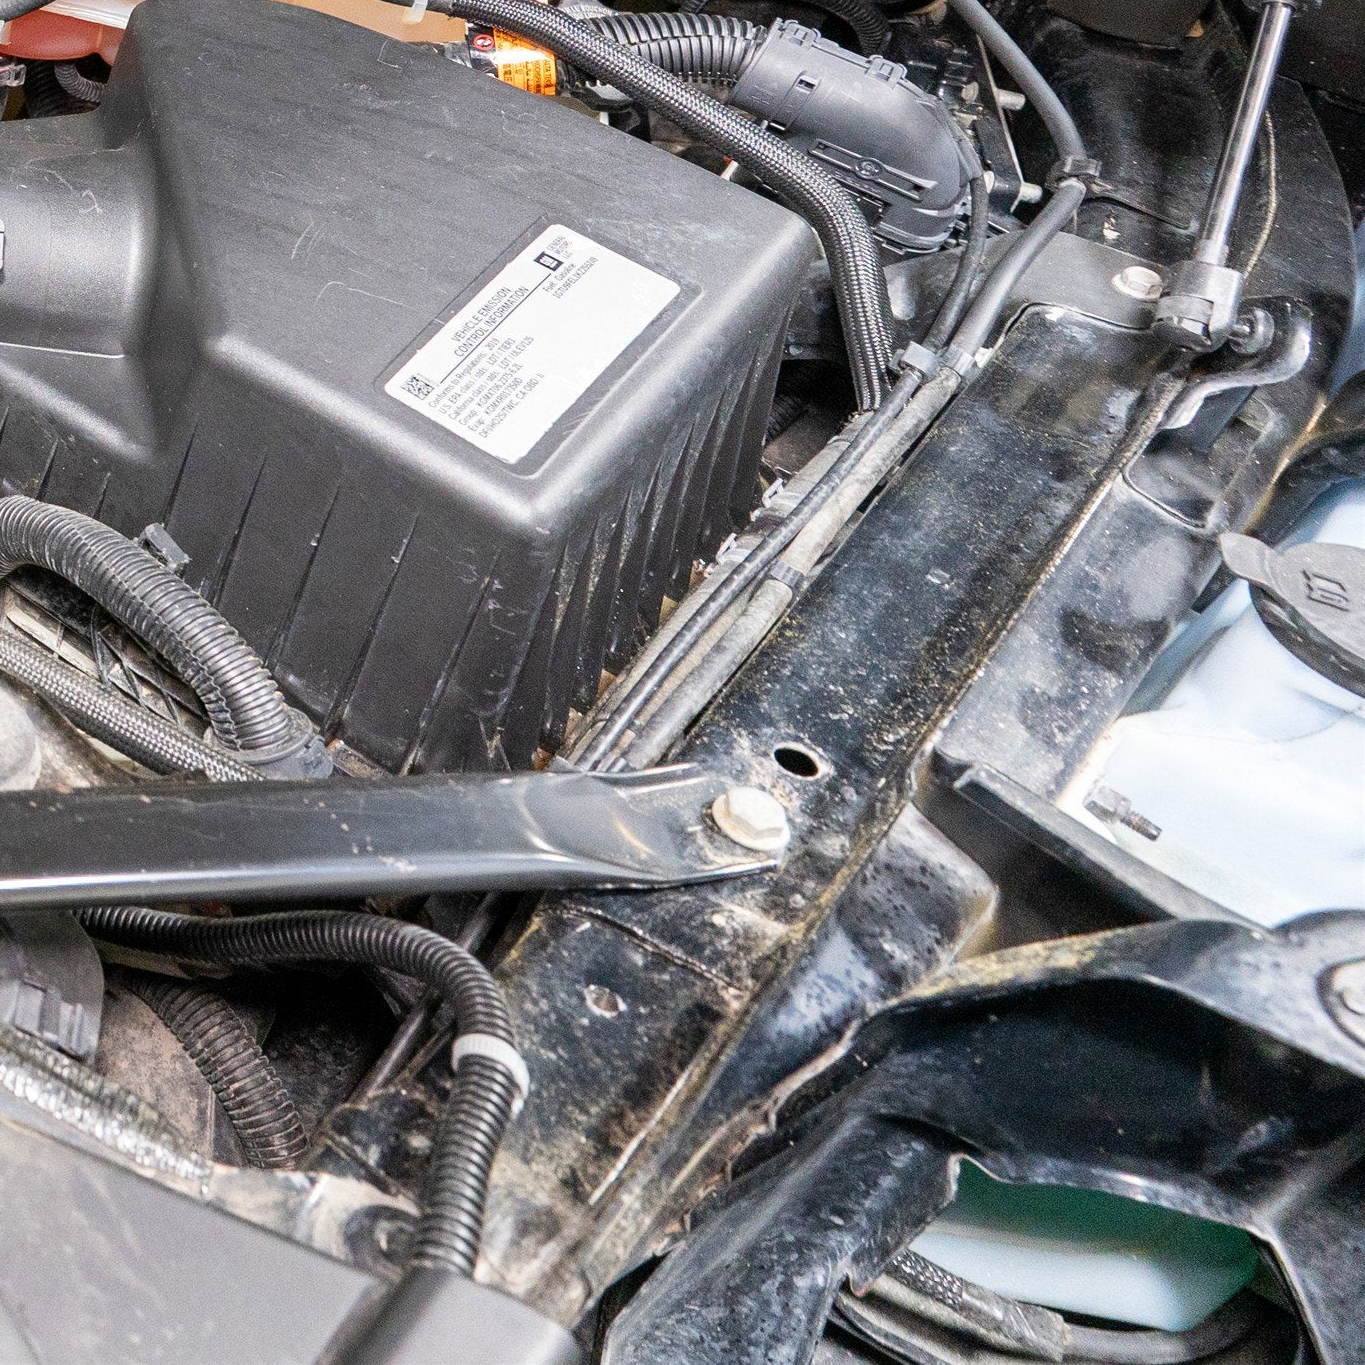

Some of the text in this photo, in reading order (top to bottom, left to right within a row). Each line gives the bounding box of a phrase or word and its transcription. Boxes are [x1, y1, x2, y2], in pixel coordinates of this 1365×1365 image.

[452, 287, 511, 341] VEHICLE EMISSION
[454, 286, 528, 356] CONTROL INFORMATION
[428, 385, 454, 407] Conforms
[448, 392, 461, 403] EPA
[515, 390, 527, 399] CA
[448, 397, 474, 419] California
